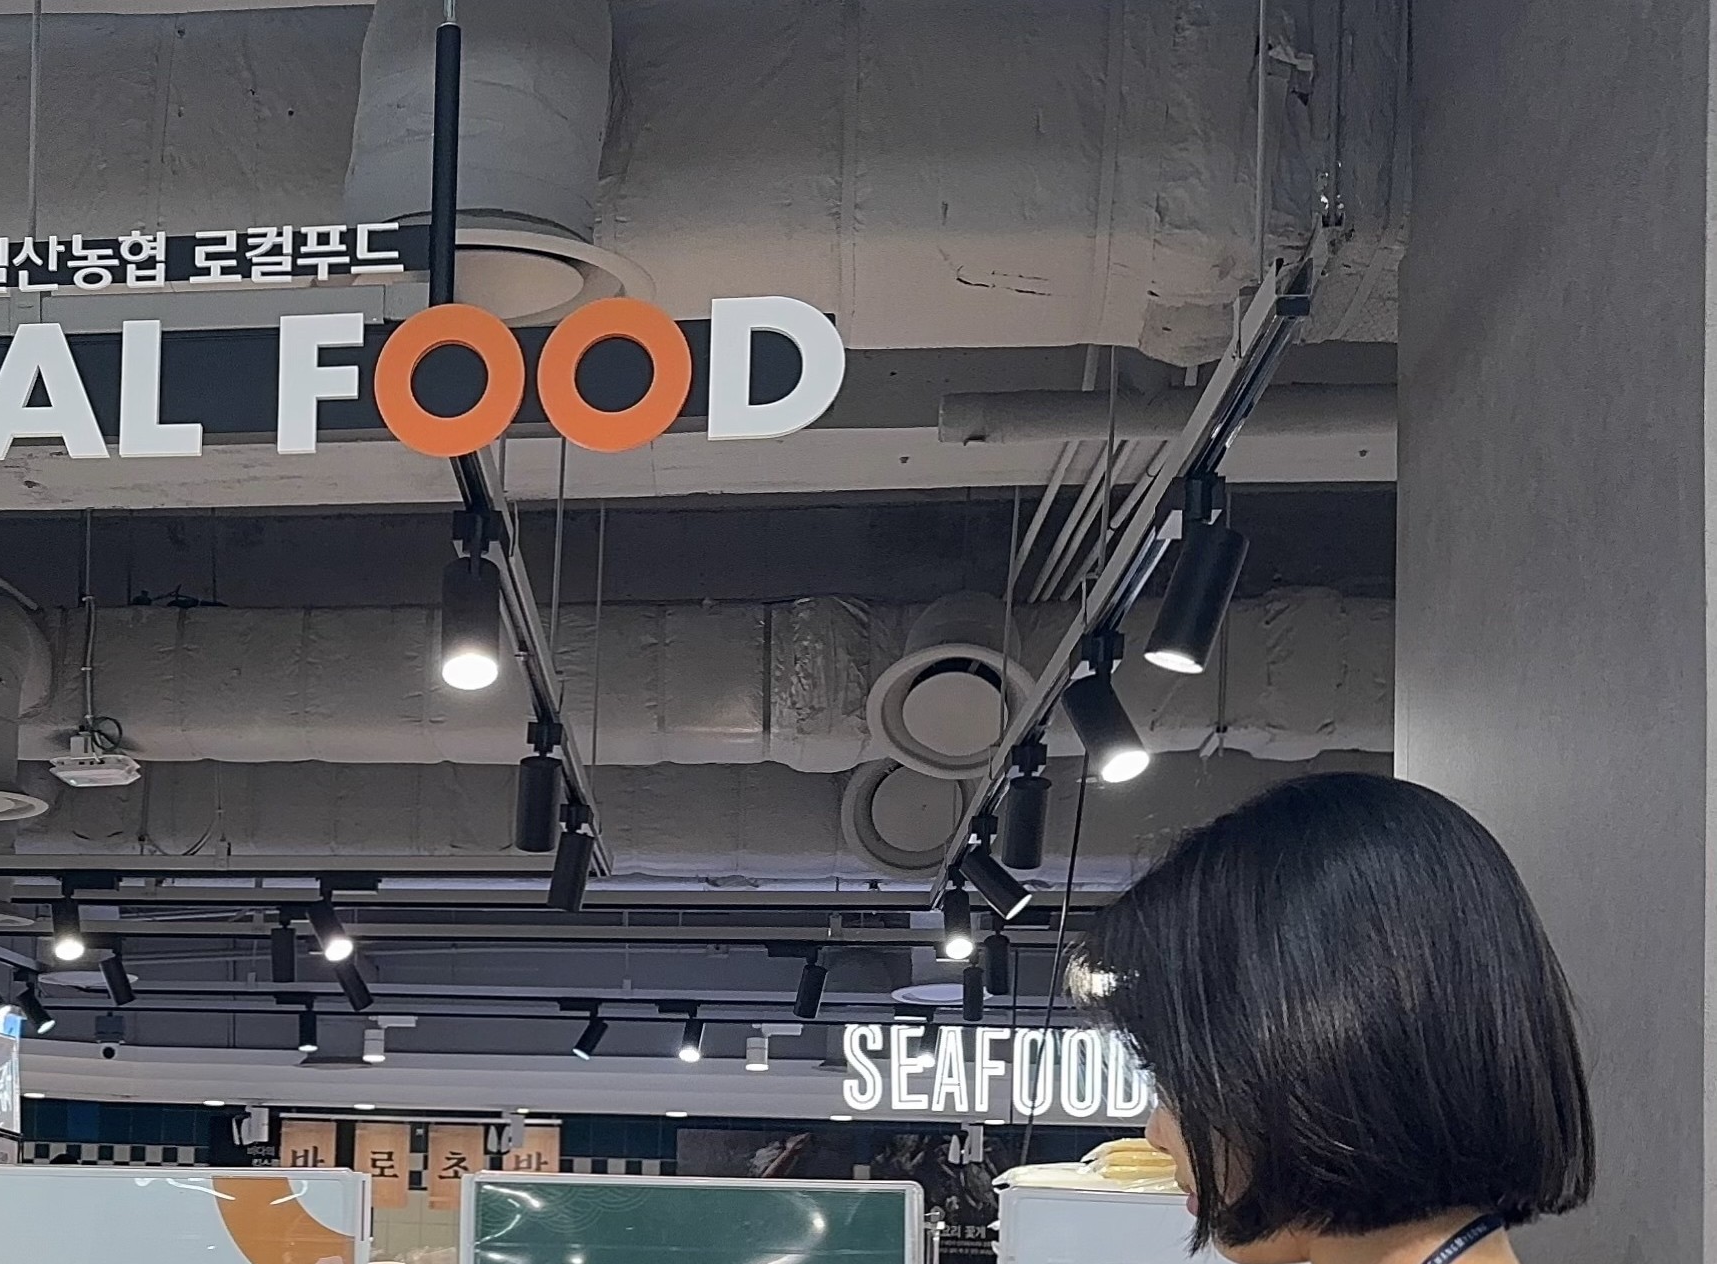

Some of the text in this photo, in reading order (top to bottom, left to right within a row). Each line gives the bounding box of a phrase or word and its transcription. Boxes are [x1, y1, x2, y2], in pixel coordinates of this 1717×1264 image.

[193, 222, 404, 283] 로컬푸드
[277, 296, 846, 457] FOOD
[842, 1024, 1156, 1118] SEAFOOD
